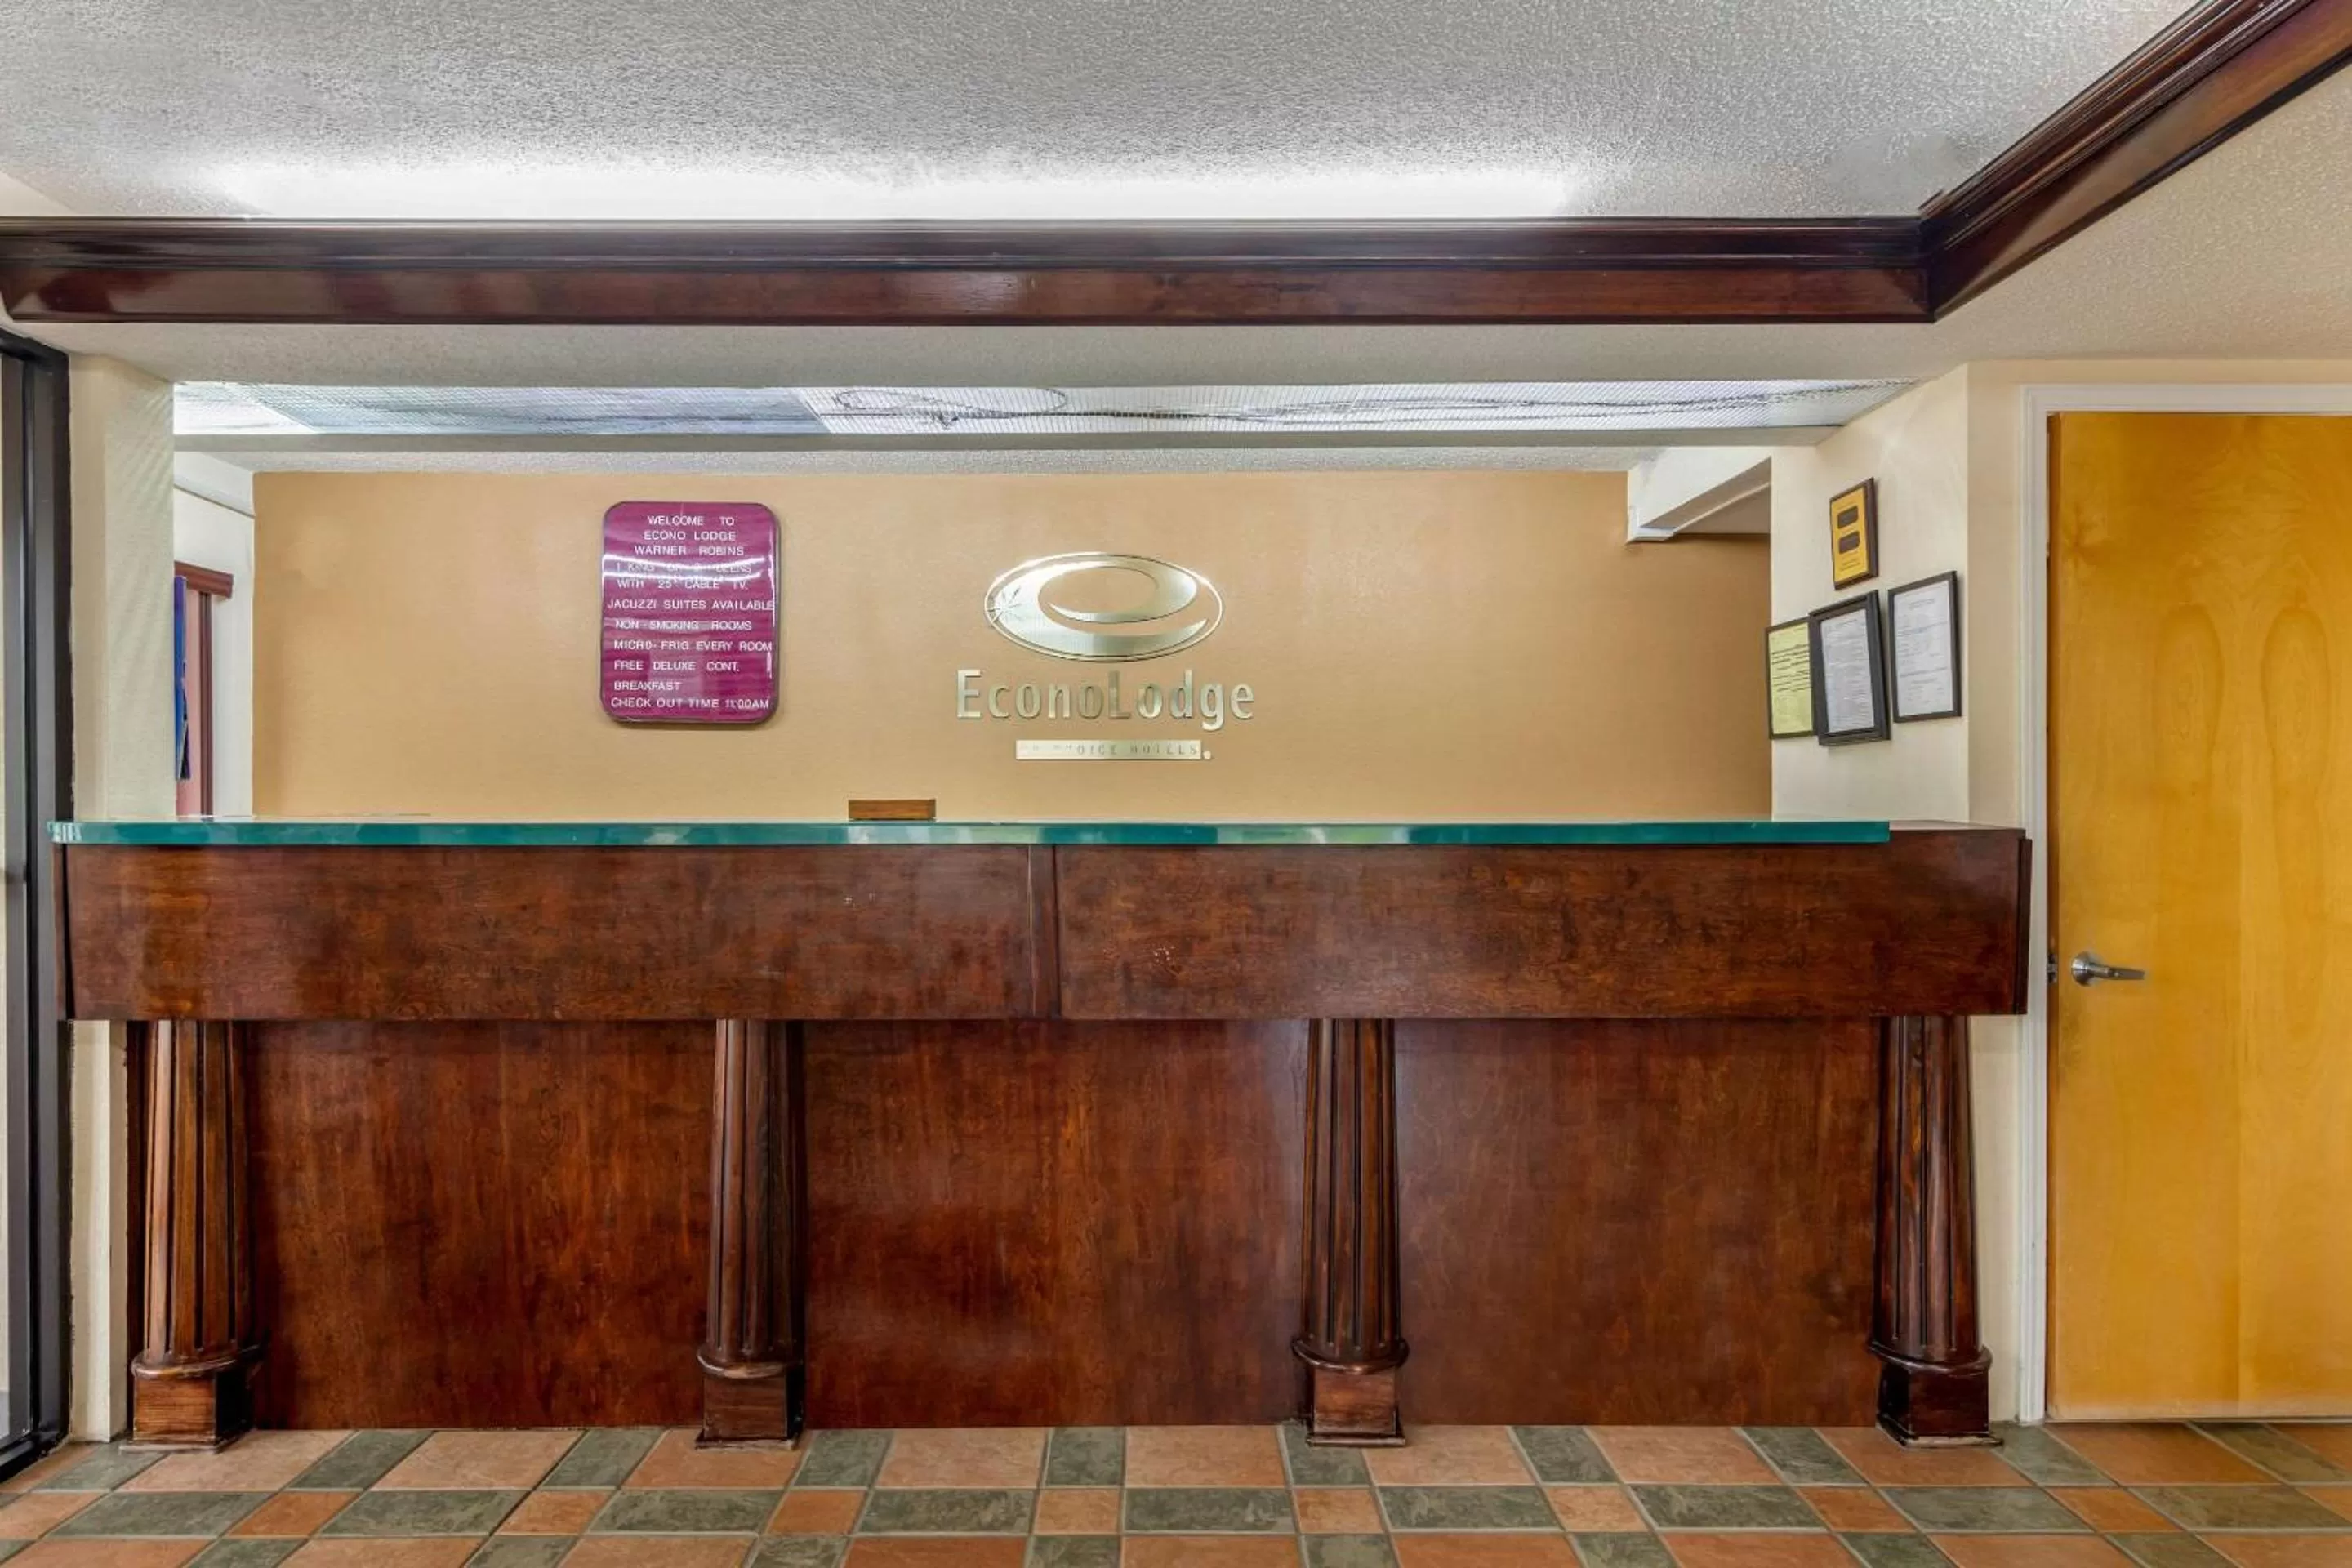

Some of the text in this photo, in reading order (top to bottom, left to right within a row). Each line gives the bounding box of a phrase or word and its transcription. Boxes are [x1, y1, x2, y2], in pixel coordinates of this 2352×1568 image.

[647, 515, 735, 527] WELCOME TO
[644, 531, 737, 542] ECONO LODGE
[634, 546, 744, 556] WARNER ROBINS
[617, 578, 645, 589] WITH
[684, 578, 720, 589] CABLE
[608, 599, 774, 611] JACUZZI SUITES AVAILABLE
[648, 620, 699, 630] SMOKING
[711, 620, 752, 630] ROOMS
[661, 640, 690, 651] FRIG
[696, 640, 733, 651] EVERY
[739, 641, 773, 652] ROOM
[614, 660, 740, 672] FREE DELUXE CONT.
[614, 680, 682, 691] BREAKFAST
[611, 697, 652, 708] CHECK
[656, 698, 683, 708] OUT
[688, 698, 720, 709] TIME
[956, 668, 1255, 732] EconoLodge
